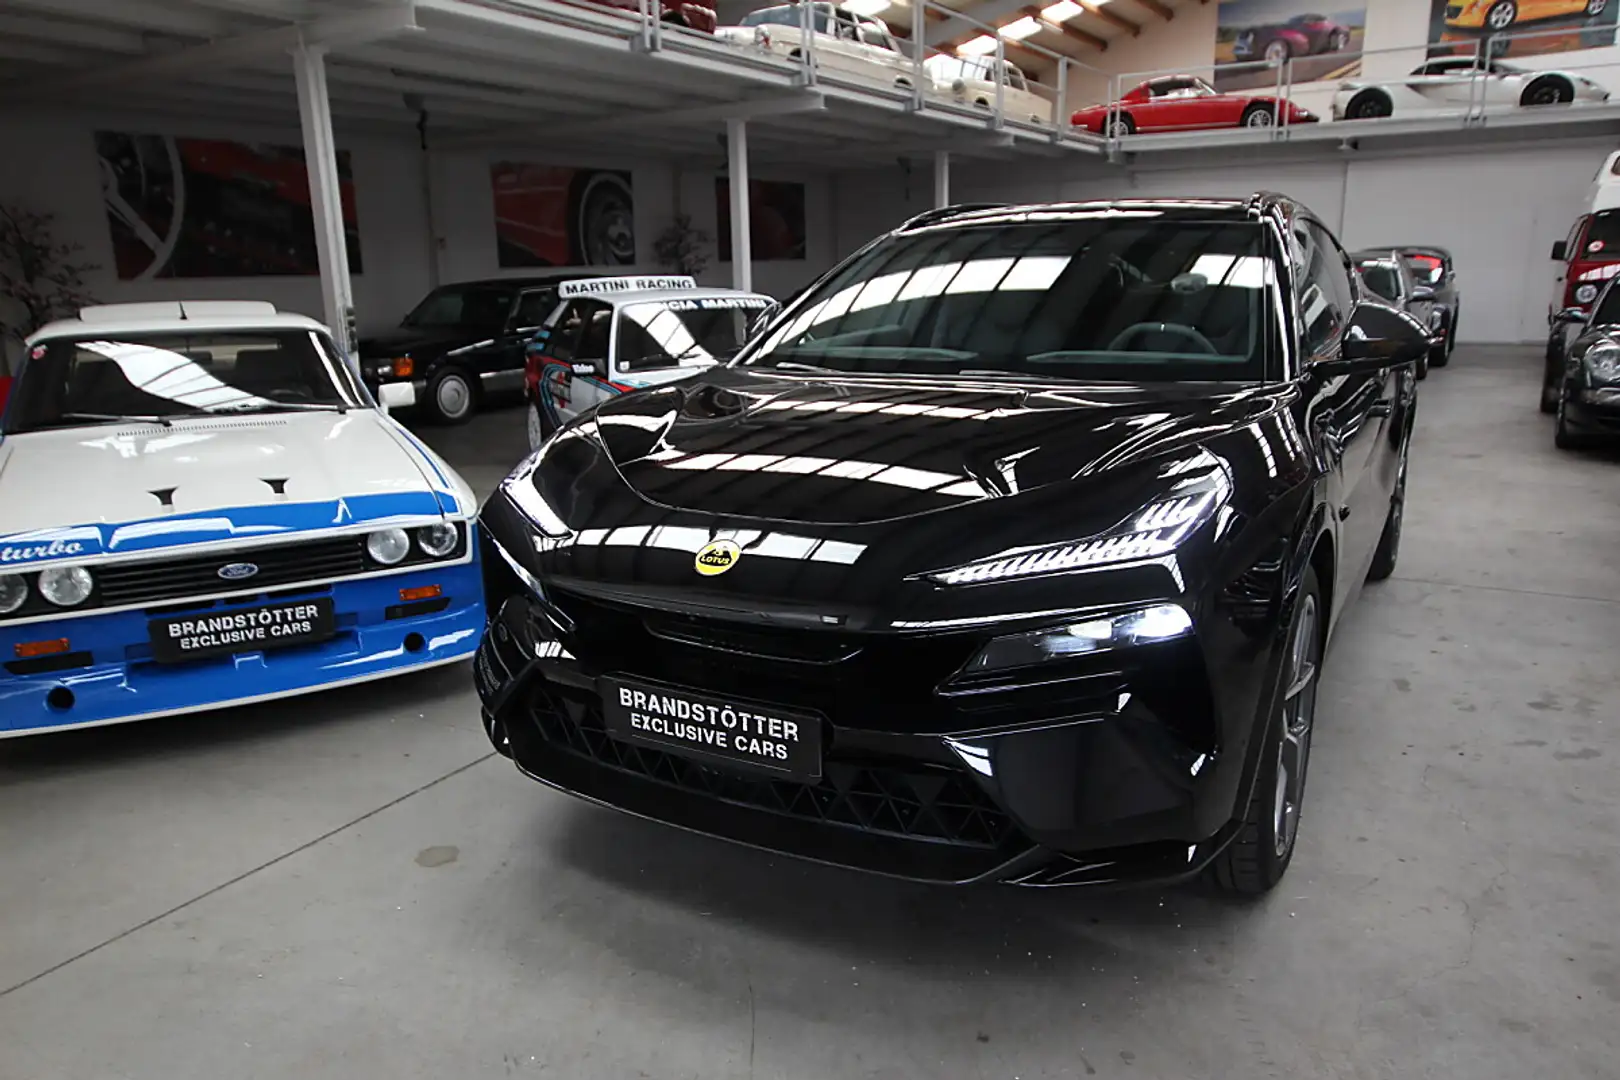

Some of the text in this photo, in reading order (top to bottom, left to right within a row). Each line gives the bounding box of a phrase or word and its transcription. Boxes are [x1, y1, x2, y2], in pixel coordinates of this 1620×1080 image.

[565, 278, 692, 294] MARTINI RACING
[700, 298, 767, 309] MARTINI
[1, 539, 84, 561] turbo
[700, 554, 730, 565] LOTUS
[168, 604, 318, 637] BRANDSTÖTTER
[180, 620, 311, 649] EXCLUSIVE CARS
[619, 687, 799, 742] BRANDSTÖTTER
[630, 712, 788, 760] EXCLUSIVE CARS
